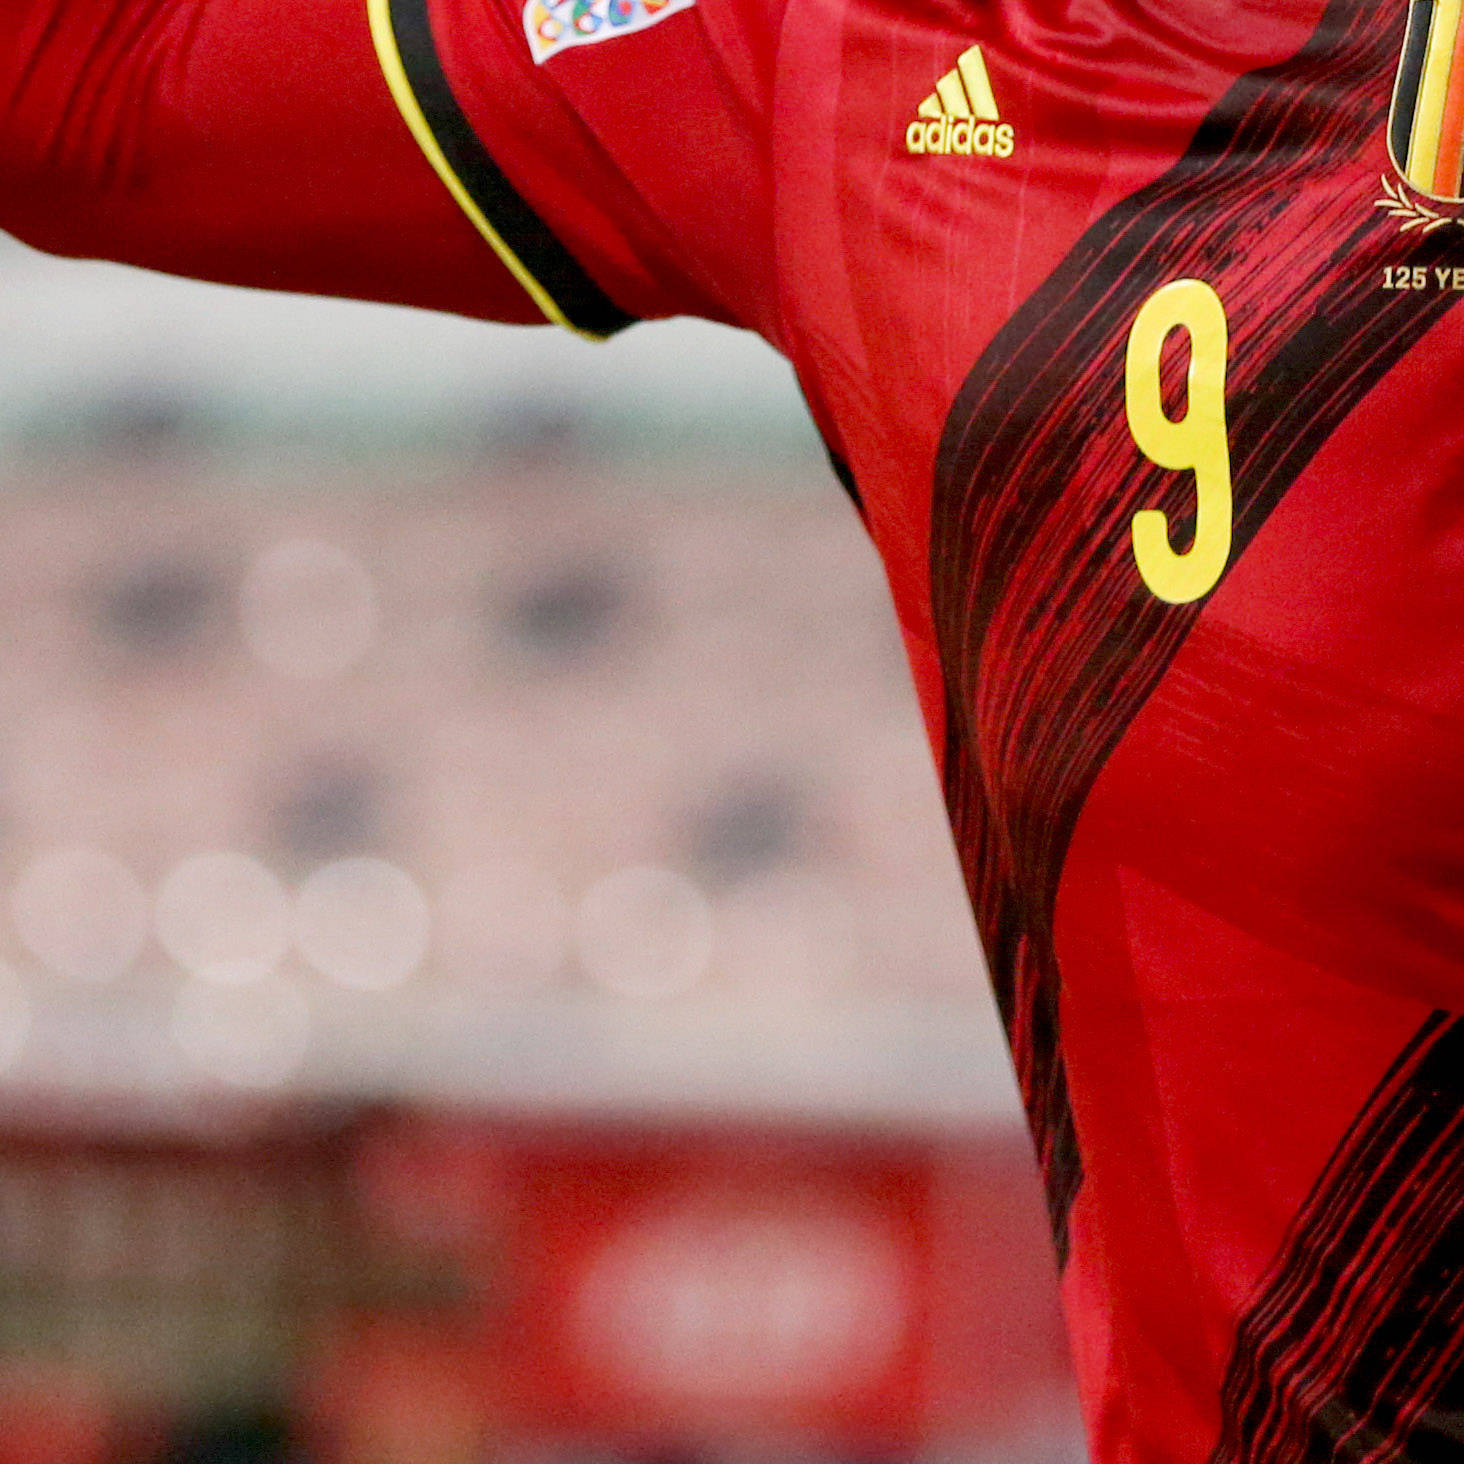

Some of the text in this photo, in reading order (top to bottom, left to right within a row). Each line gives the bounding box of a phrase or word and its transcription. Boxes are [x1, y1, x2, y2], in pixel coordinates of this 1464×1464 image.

[906, 115, 1014, 158] adidas
[1382, 266, 1428, 290] 125
[1126, 278, 1233, 605] 9
